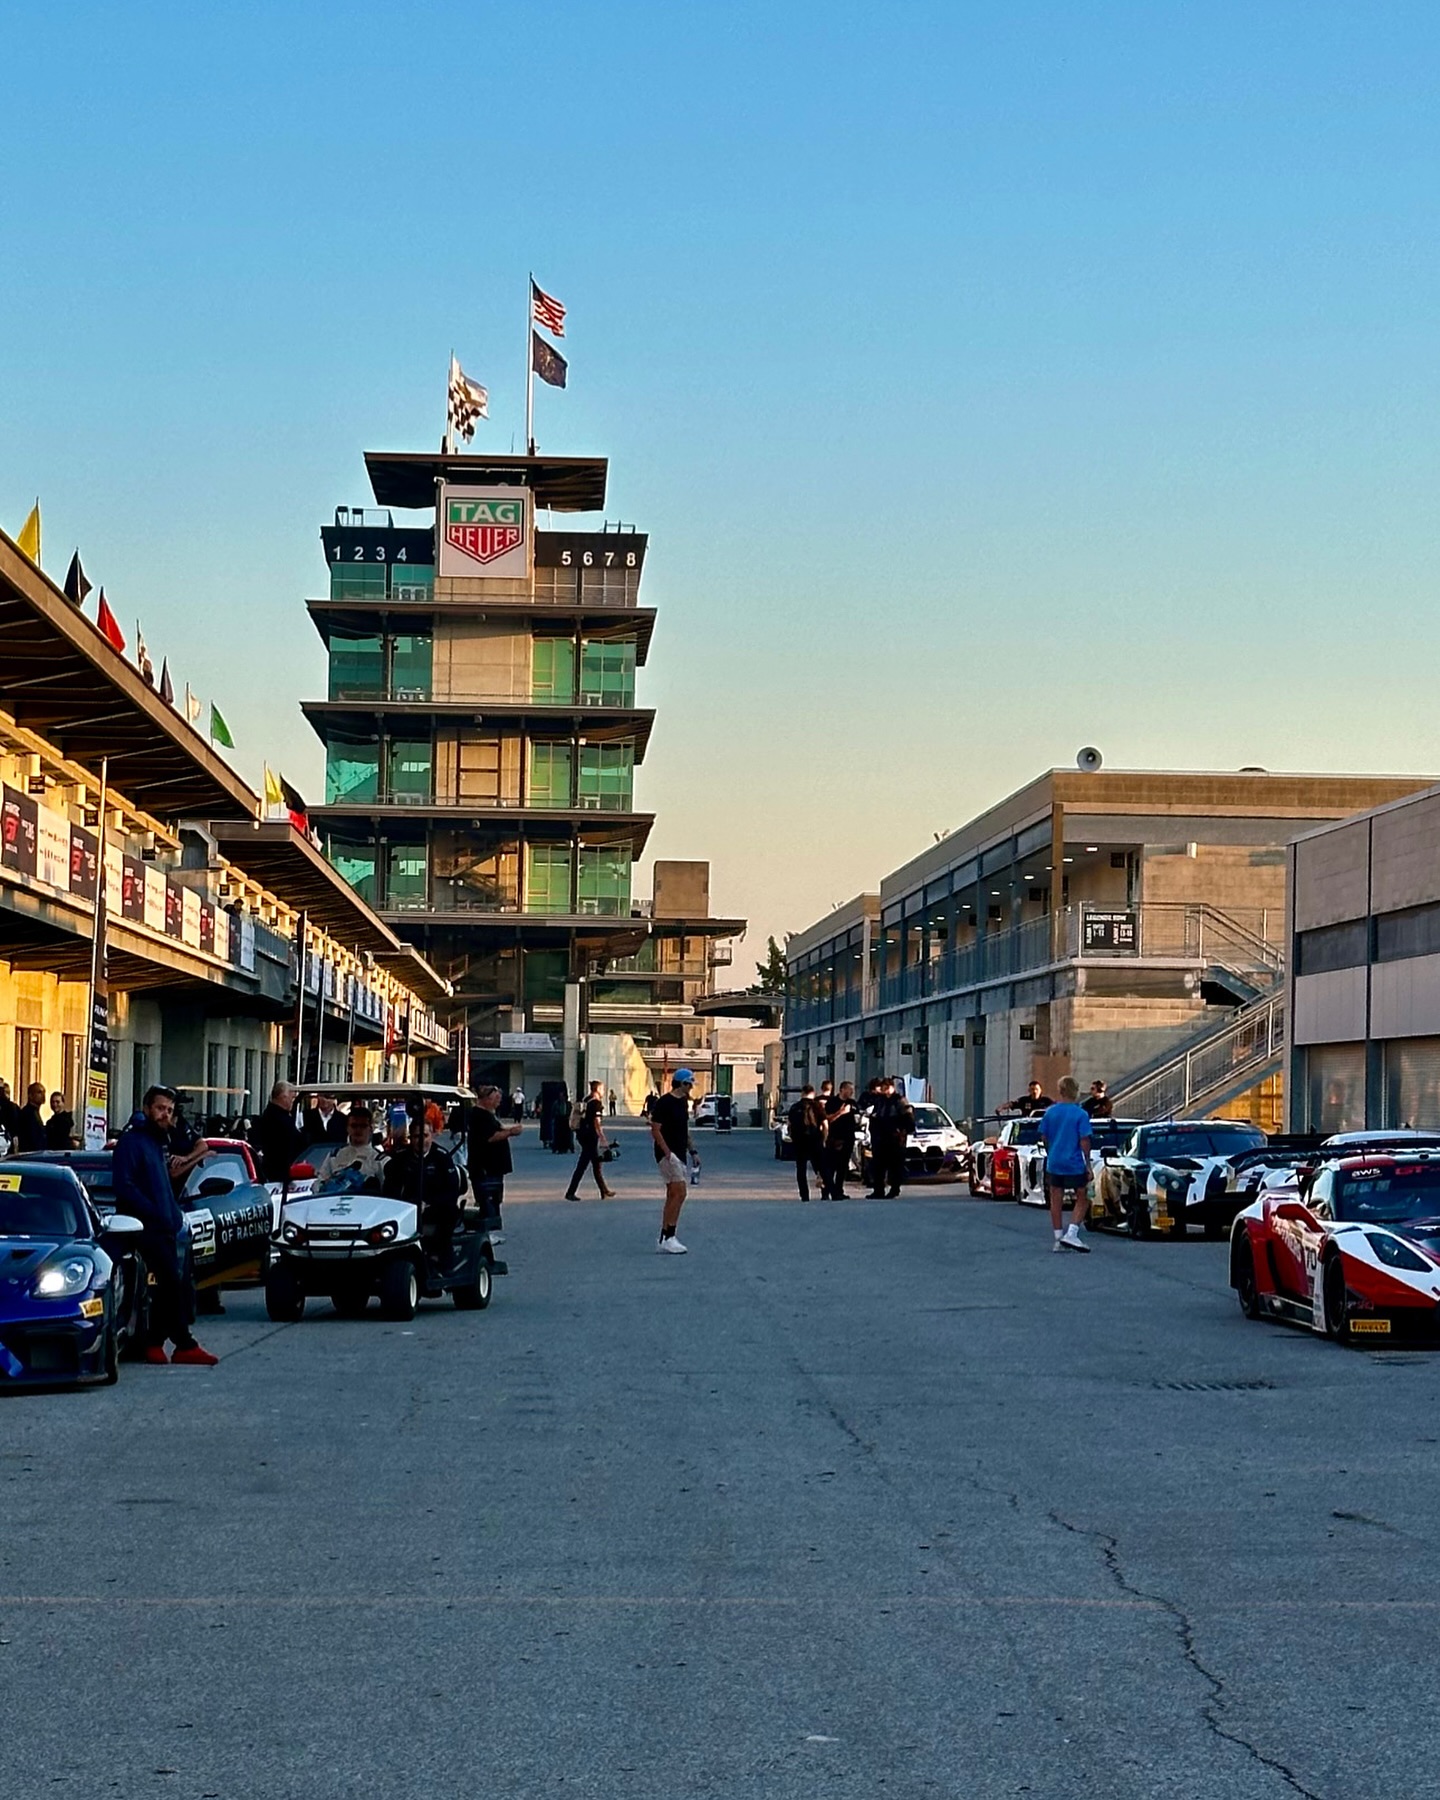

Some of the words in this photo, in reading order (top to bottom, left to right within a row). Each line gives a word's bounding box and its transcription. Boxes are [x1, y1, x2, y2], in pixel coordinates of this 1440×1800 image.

[453, 503, 515, 524] TAG
[333, 546, 341, 560] 1
[354, 547, 364, 561] 2
[375, 547, 385, 561] 3
[396, 547, 407, 561] 4
[451, 527, 518, 558] HEUER
[562, 551, 571, 565] 5
[583, 552, 593, 566] 6
[604, 552, 614, 566] 7
[626, 552, 636, 566] 8
[218, 1210, 238, 1228] THE
[239, 1203, 269, 1222] HEART
[192, 1220, 214, 1244] 25
[221, 1228, 234, 1244] OF
[237, 1220, 270, 1241] RACING
